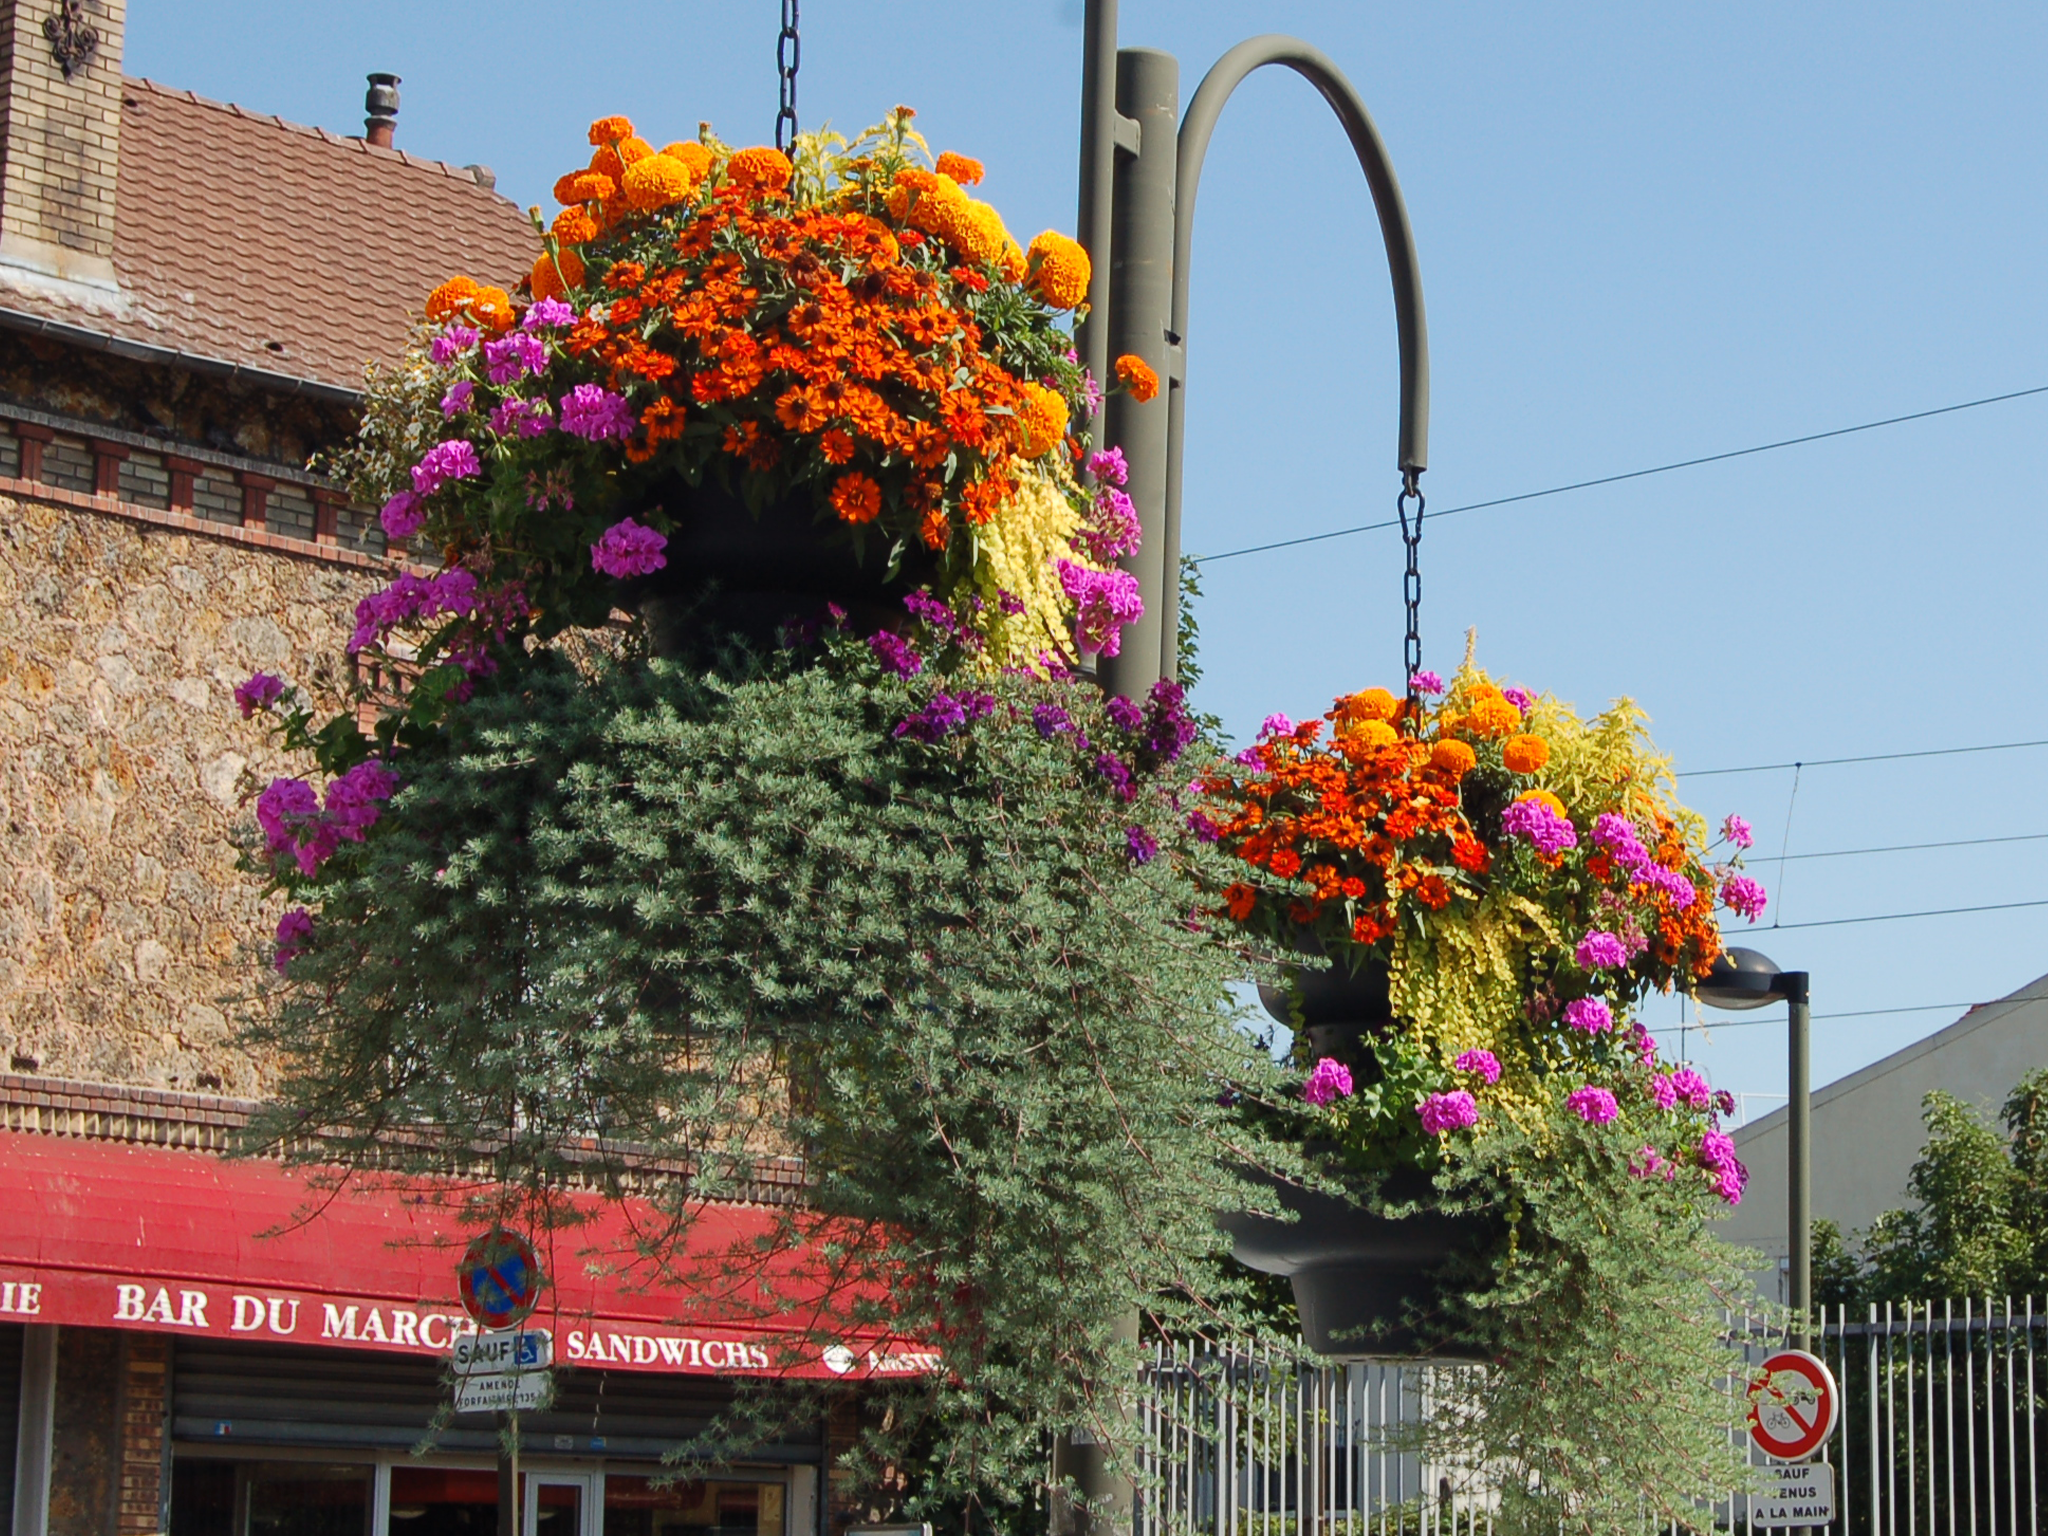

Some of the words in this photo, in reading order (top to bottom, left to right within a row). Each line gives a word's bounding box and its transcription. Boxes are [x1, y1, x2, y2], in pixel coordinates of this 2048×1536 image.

[113, 1284, 210, 1329] BAR
[231, 1294, 300, 1335] DU
[458, 1342, 510, 1364] SAUF
[567, 1330, 769, 1370] SANDWICHS
[1771, 1487, 1816, 1499] ENUS
[1756, 1508, 1764, 1519] A
[1770, 1508, 1787, 1518] LA
[1793, 1506, 1828, 1518] MAIN
